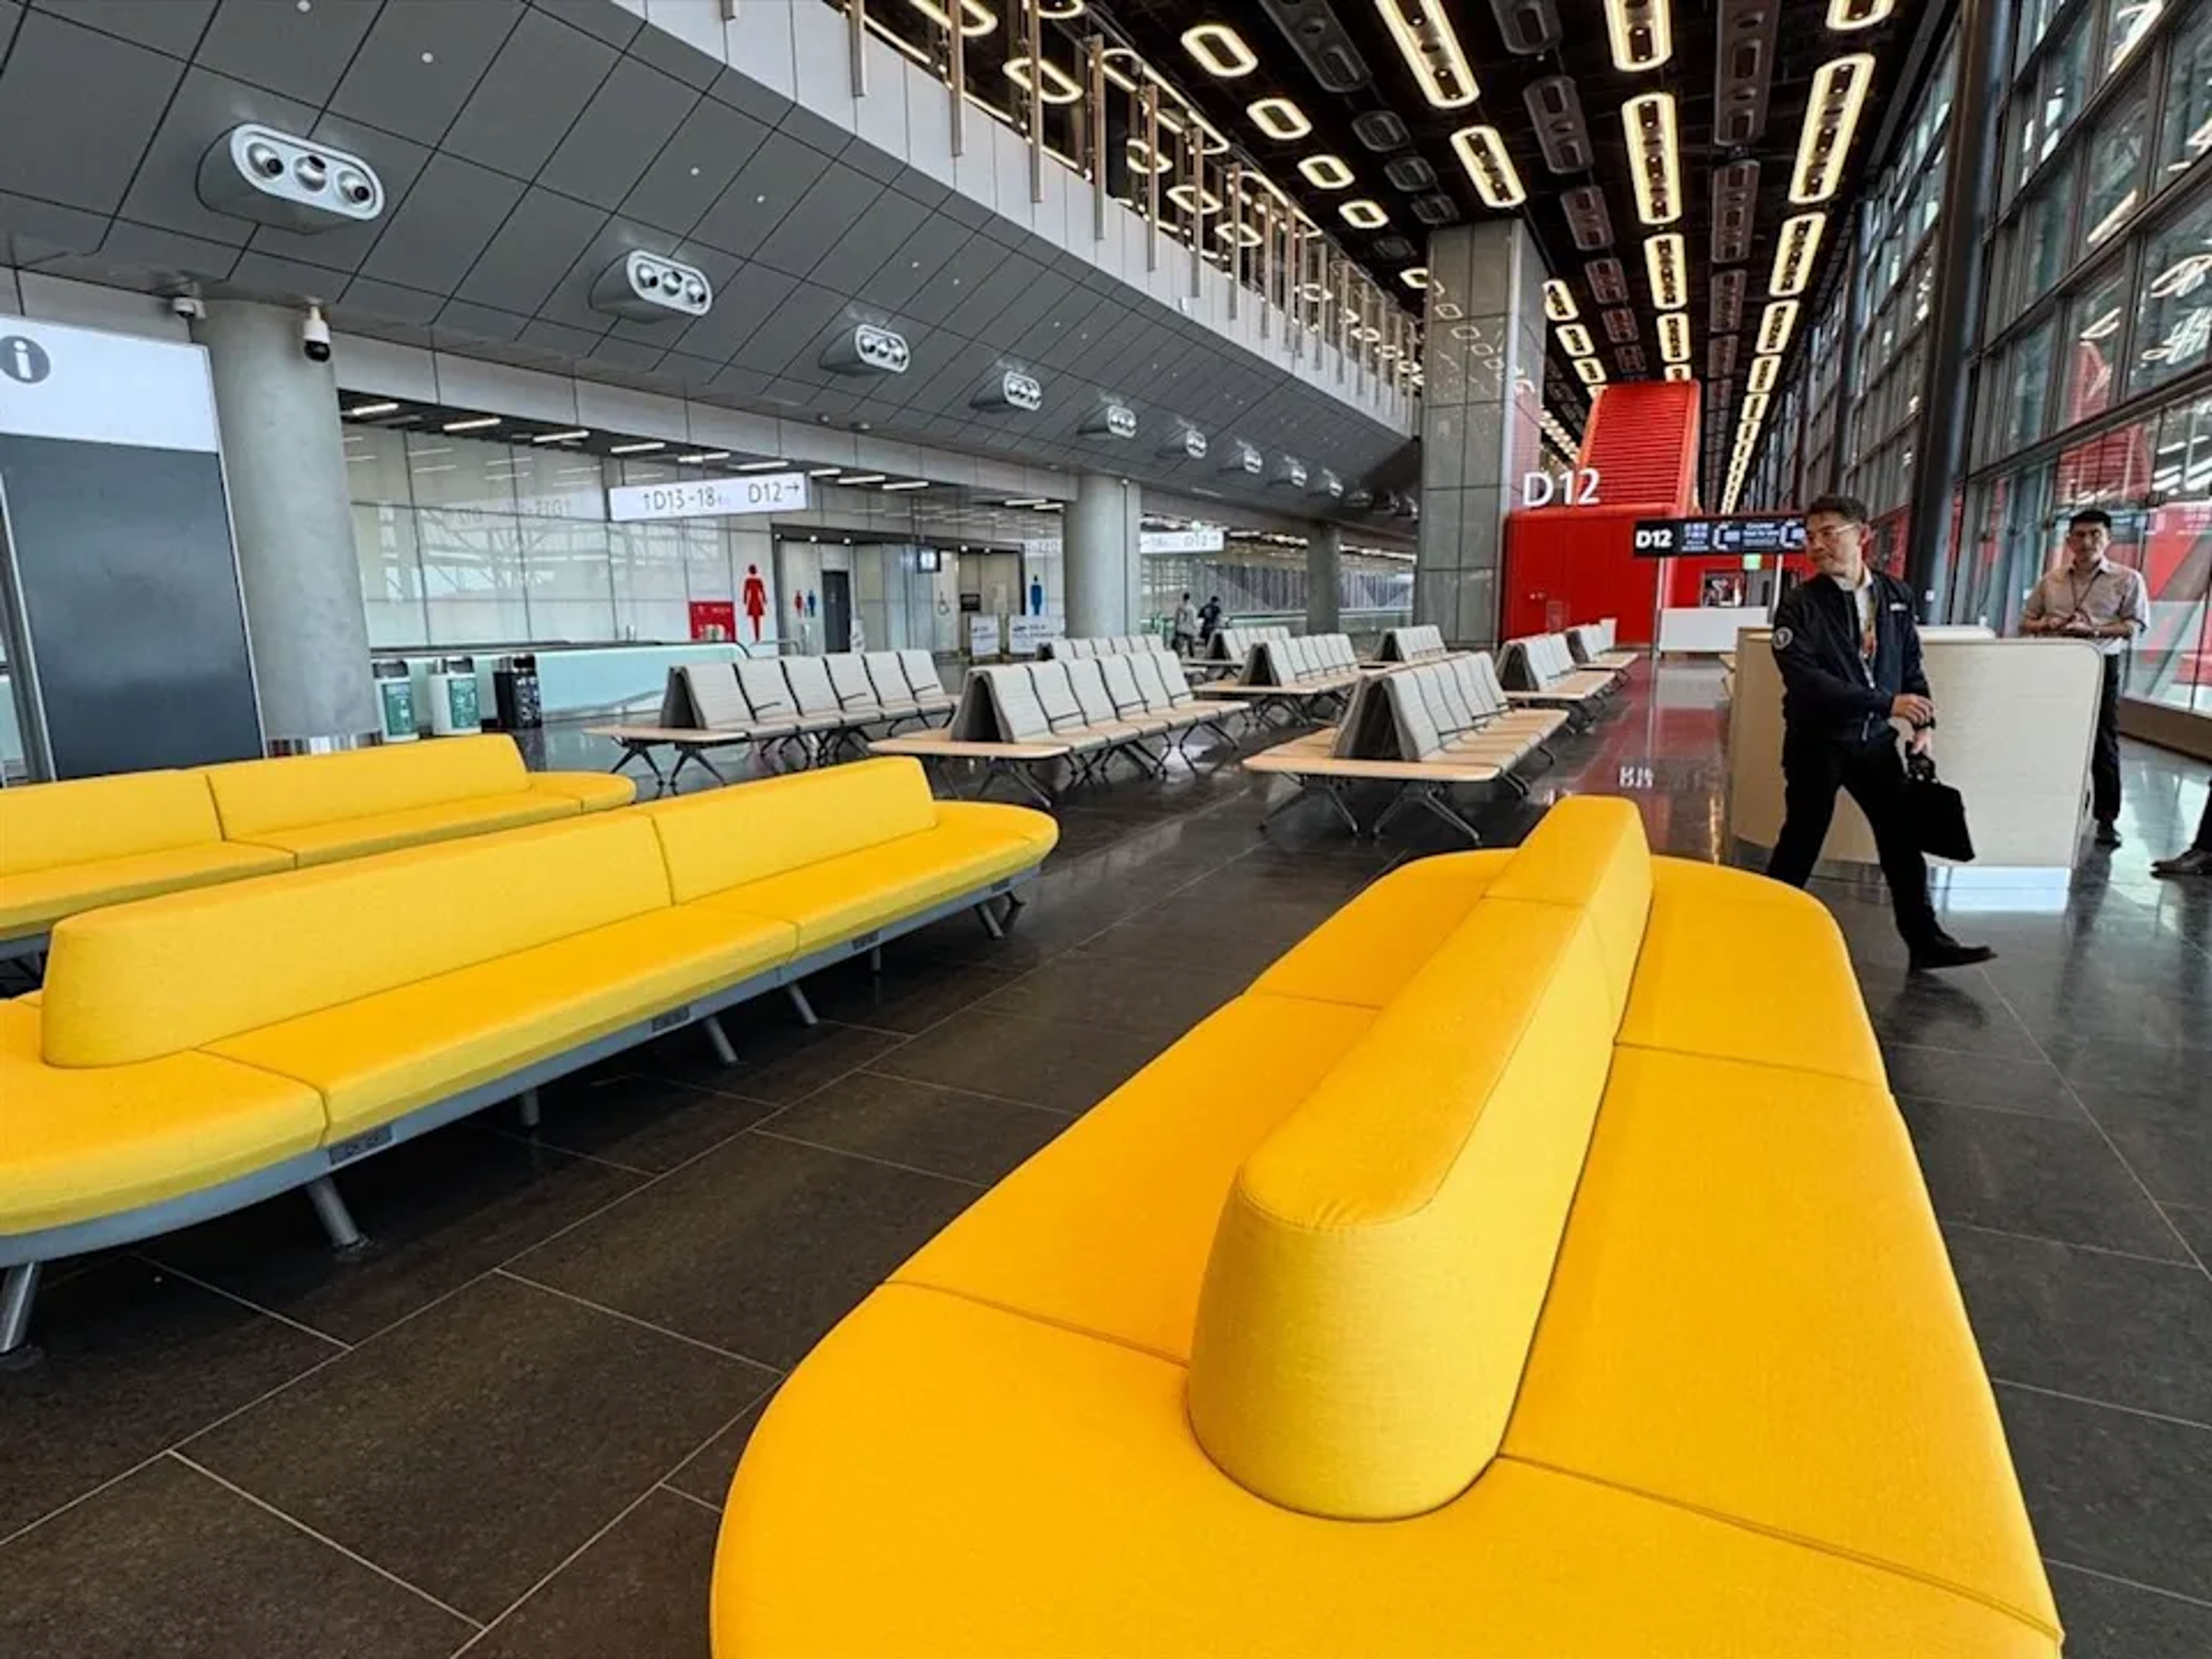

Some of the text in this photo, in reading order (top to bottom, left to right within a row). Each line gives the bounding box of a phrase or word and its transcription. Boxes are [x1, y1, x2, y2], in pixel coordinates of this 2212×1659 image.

[747, 482, 782, 503] D12
[1523, 468, 1601, 506] D12
[1636, 530, 1673, 548] D12
